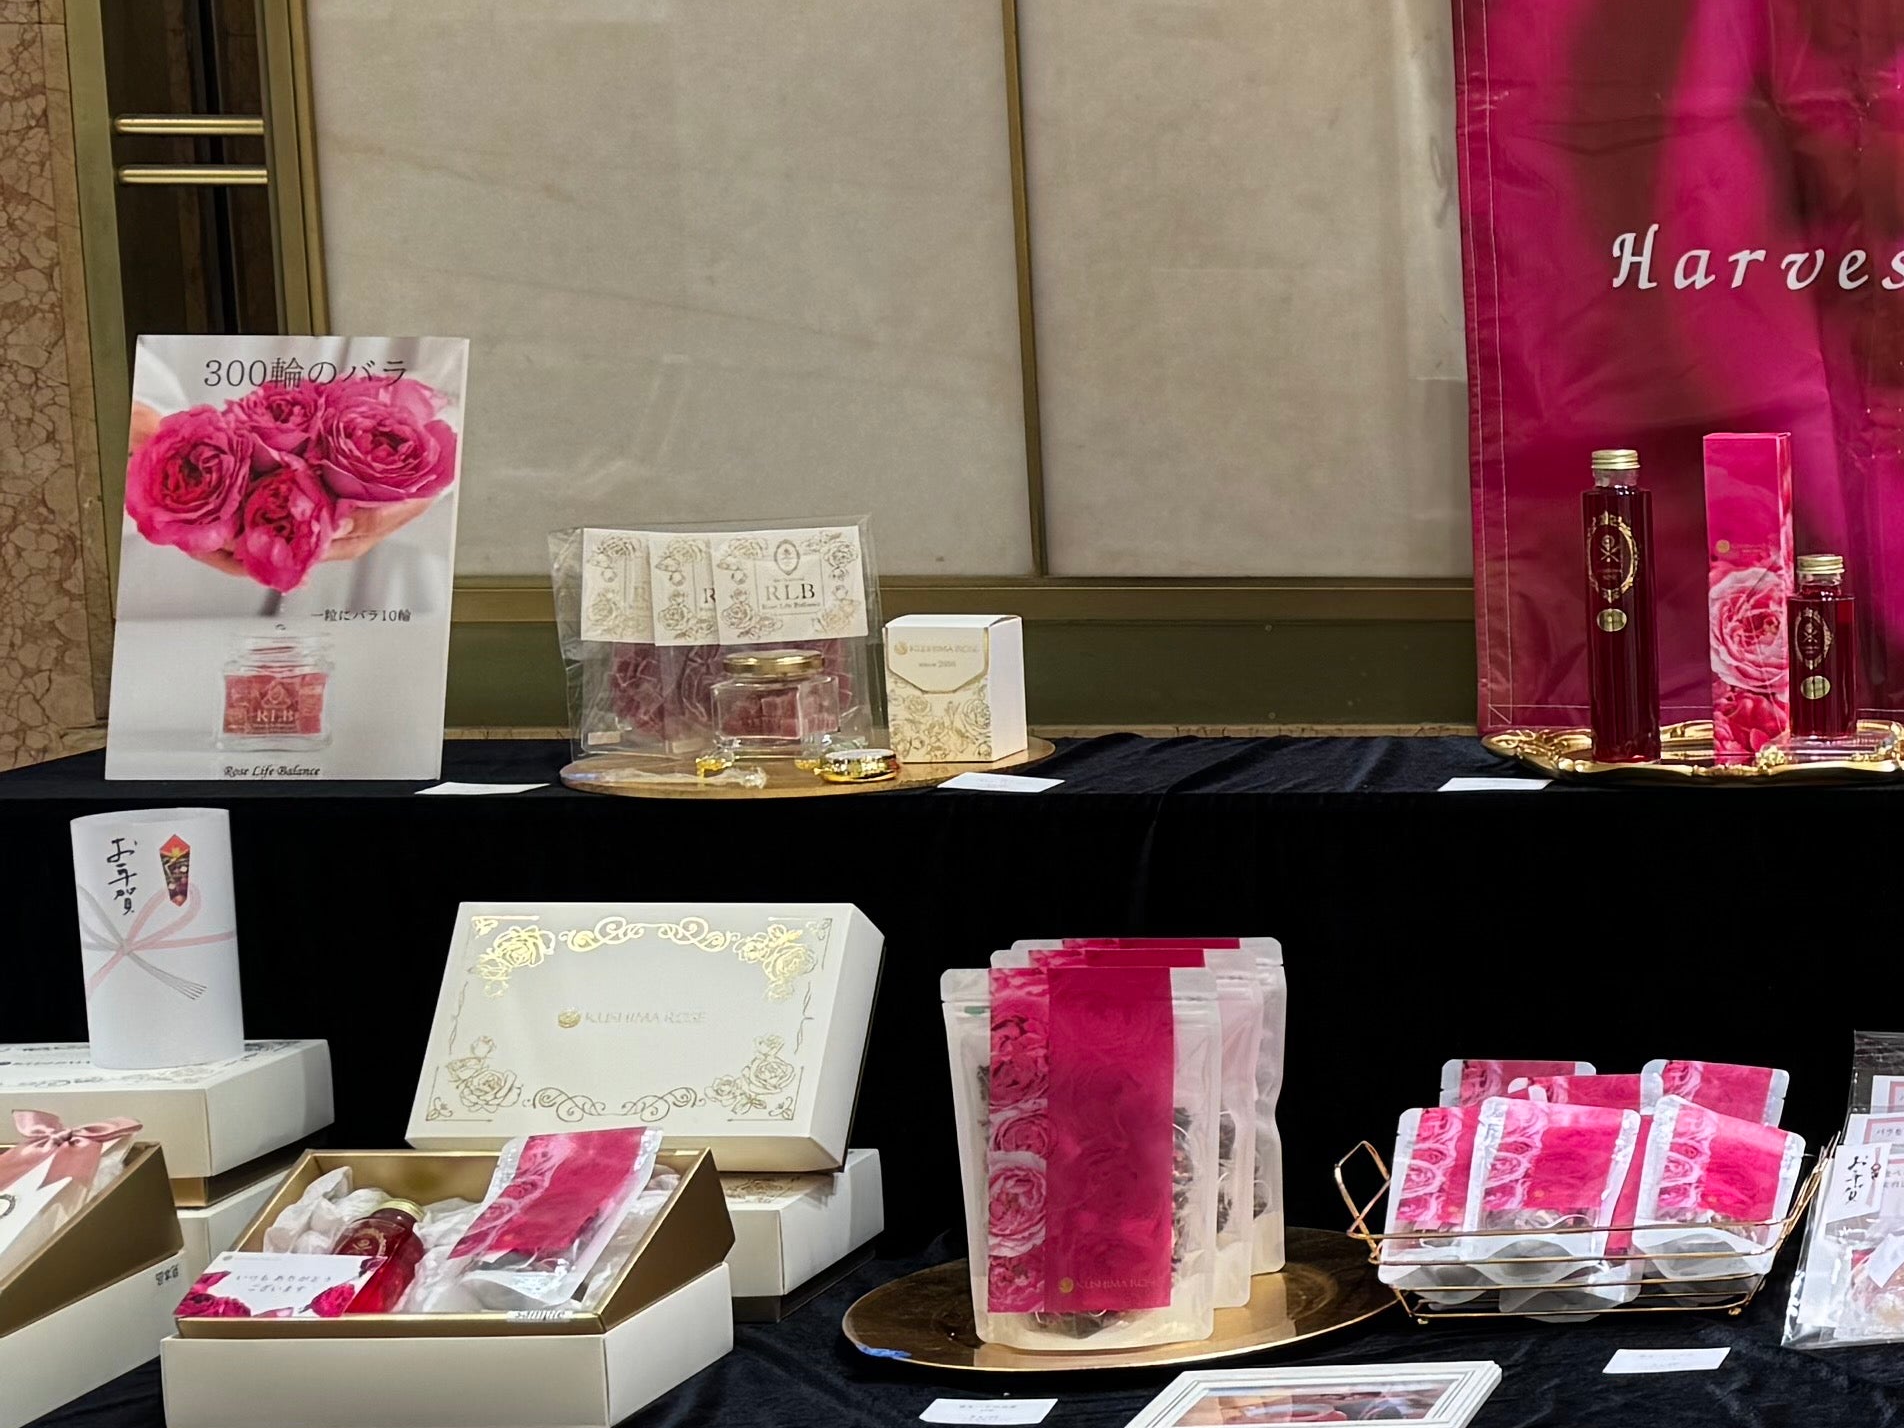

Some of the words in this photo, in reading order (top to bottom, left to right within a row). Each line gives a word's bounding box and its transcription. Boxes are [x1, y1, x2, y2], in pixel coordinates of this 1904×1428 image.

[203, 356, 409, 390] 300輪のバラ
[765, 583, 815, 601] RLB
[310, 608, 412, 624] 一粒にバラ10輪
[252, 762, 275, 779] Life
[106, 836, 138, 916] お年賀
